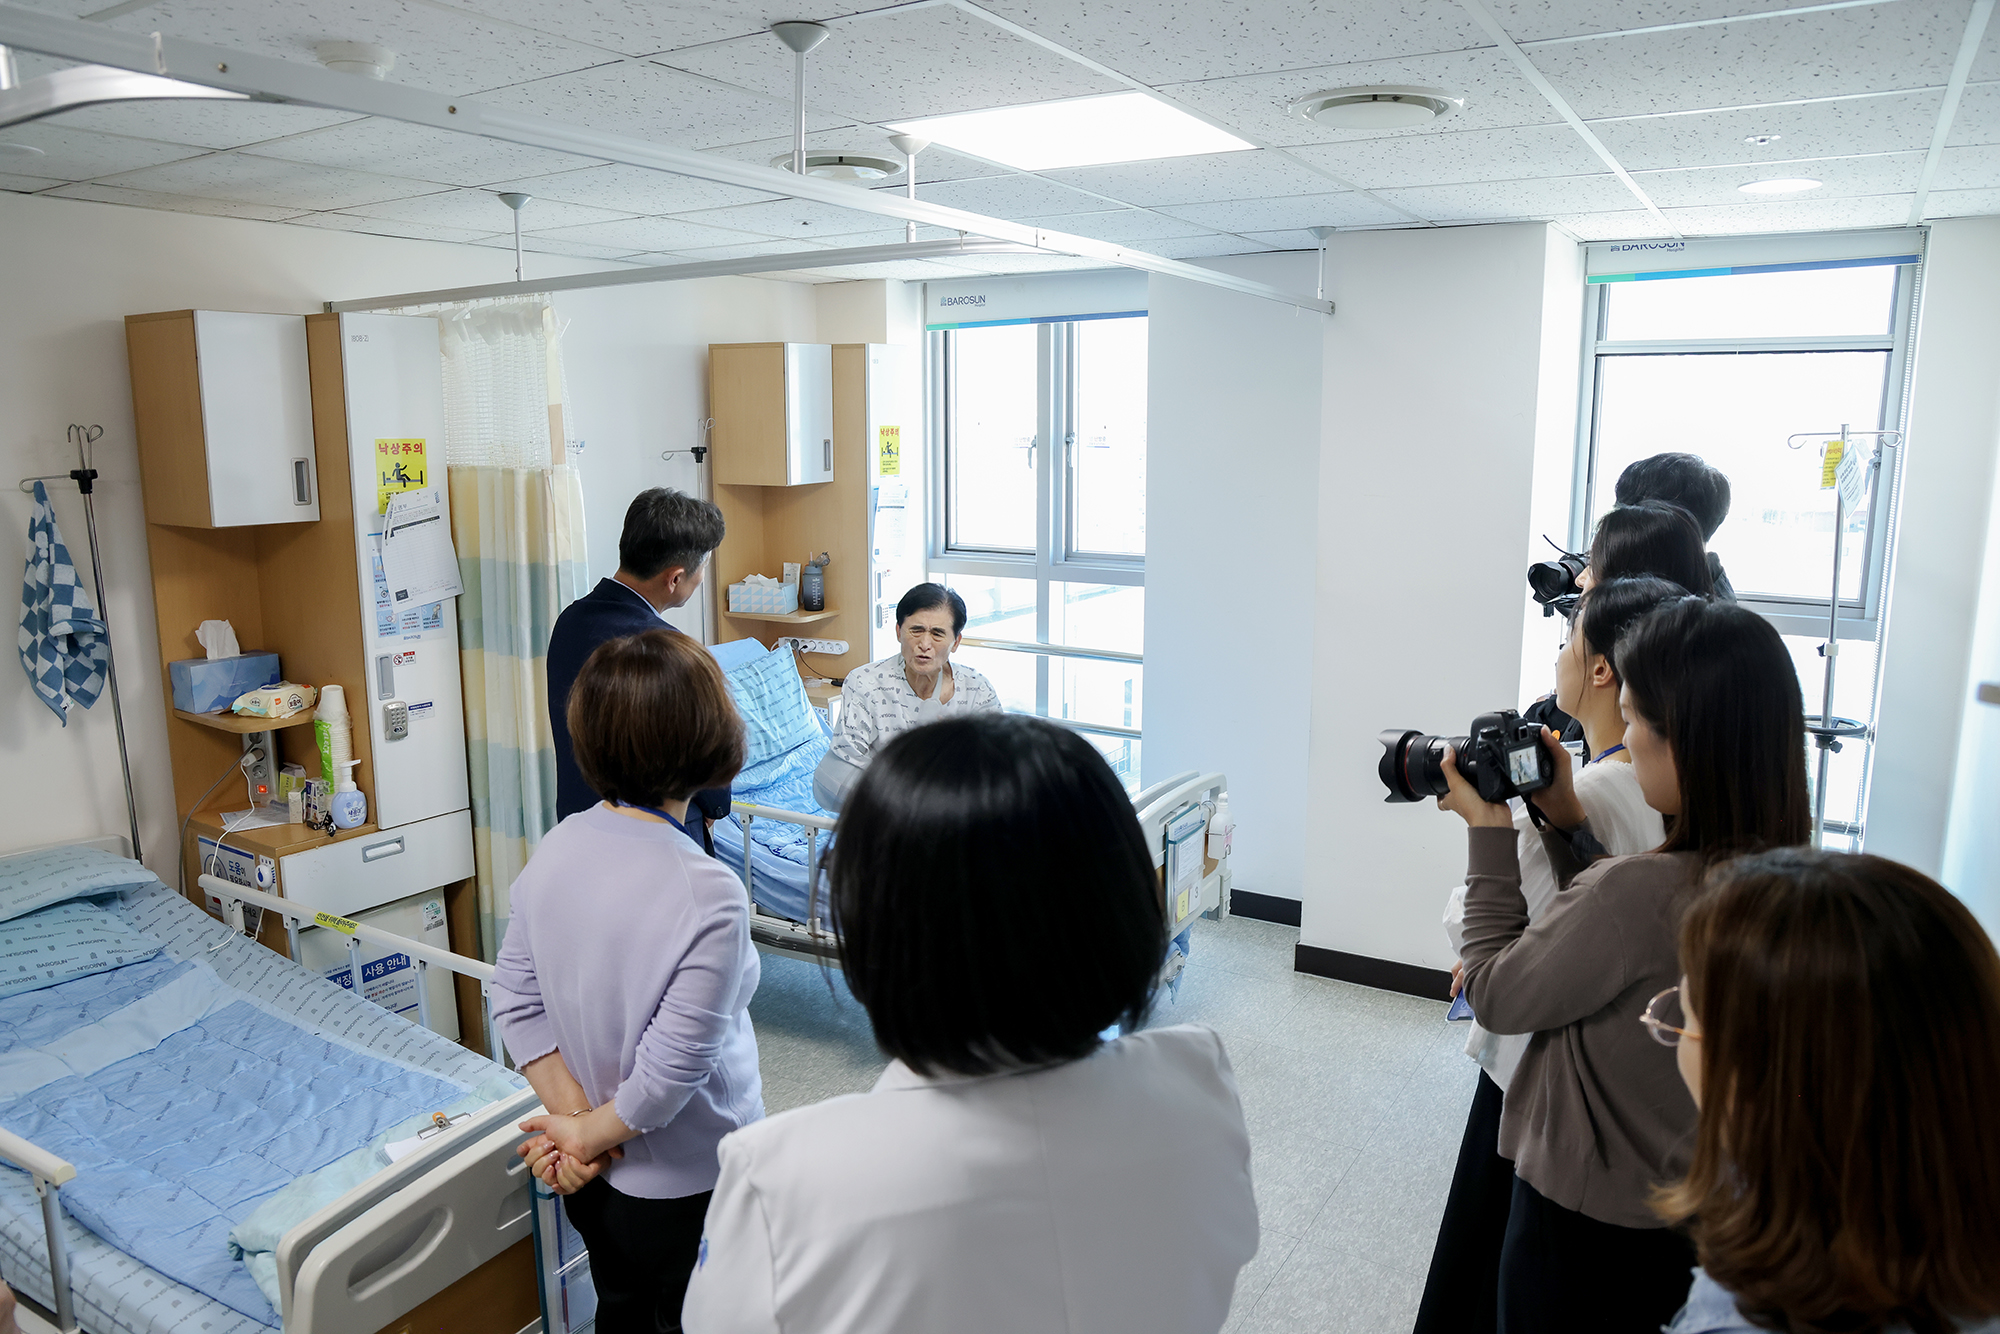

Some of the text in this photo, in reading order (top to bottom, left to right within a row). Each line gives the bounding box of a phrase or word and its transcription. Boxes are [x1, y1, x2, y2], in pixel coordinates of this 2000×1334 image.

[947, 295, 986, 306] BAROSUN
[880, 428, 899, 437] 낙상주의
[378, 442, 423, 455] 낙상주의
[228, 860, 247, 877] 도움이
[12, 891, 42, 905] BAROSUN
[5, 949, 38, 958] BAROSUN
[36, 959, 68, 969] BAROSUN
[76, 961, 108, 971] BAROSUN
[365, 962, 385, 977] 사용
[386, 954, 407, 971] 안내
[4, 975, 37, 986] BAROSUN
